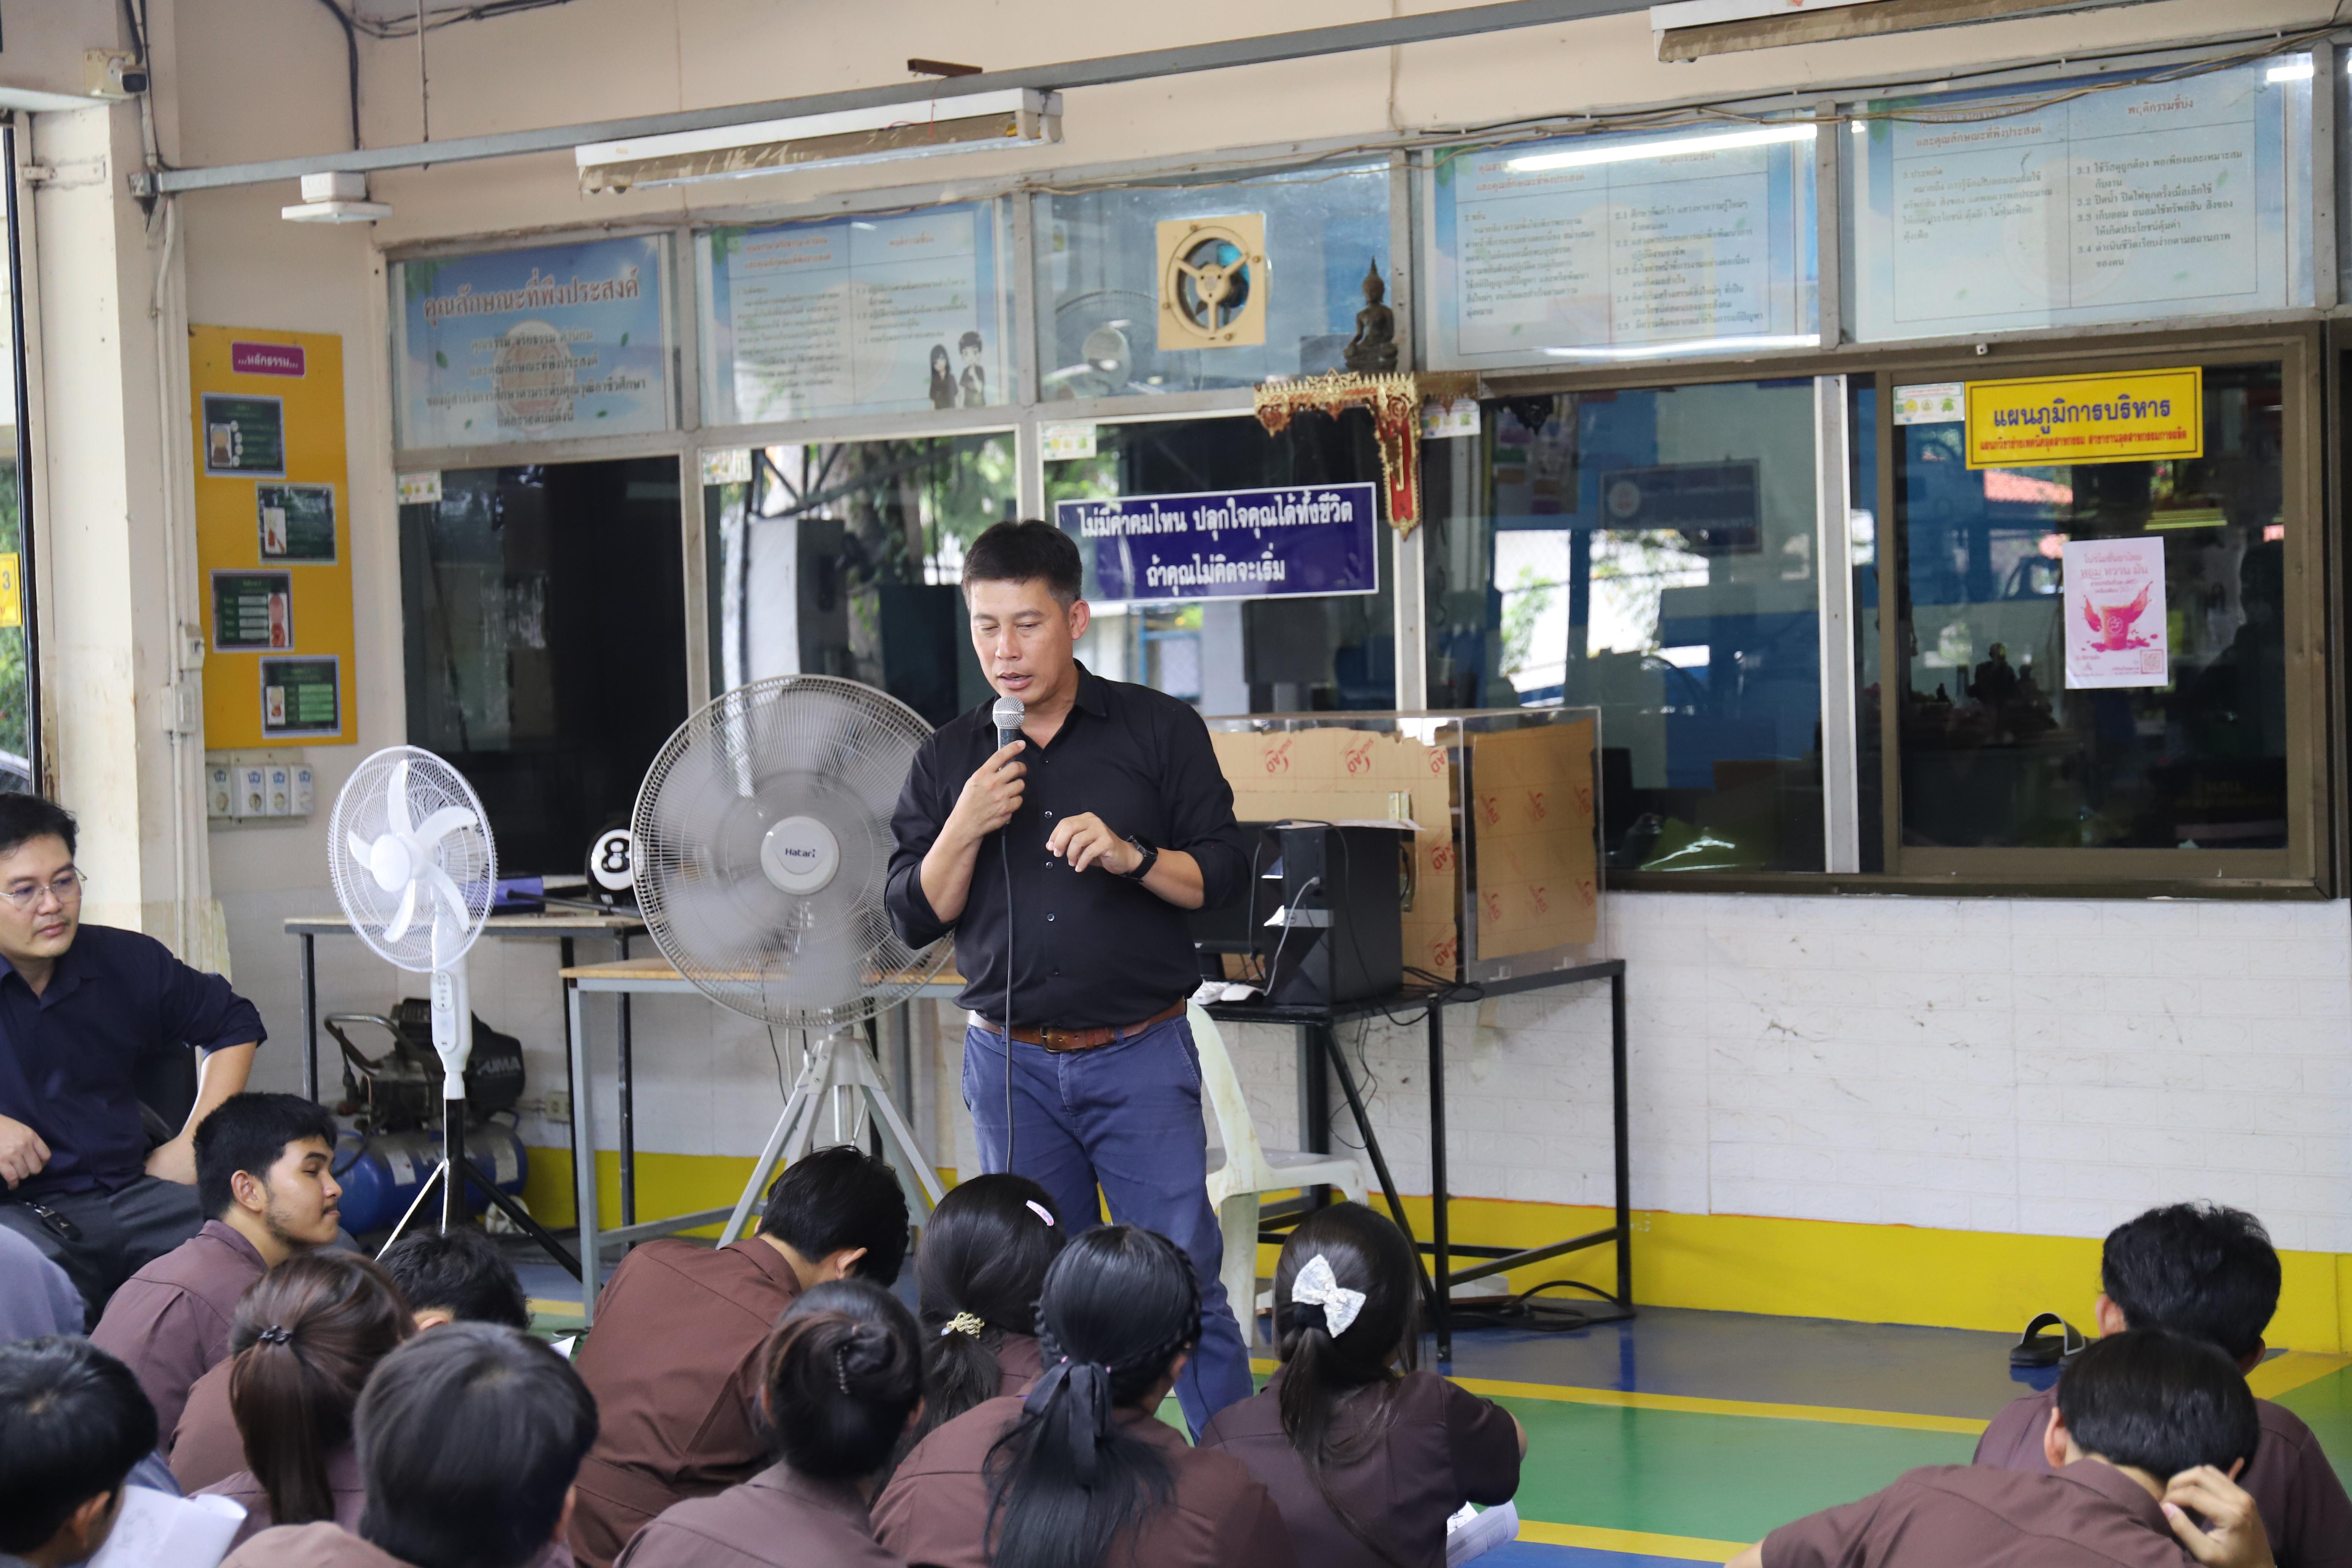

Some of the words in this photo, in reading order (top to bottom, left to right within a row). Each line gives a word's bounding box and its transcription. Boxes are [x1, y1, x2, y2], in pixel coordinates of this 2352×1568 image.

[2076, 165, 2091, 175] 3.1
[2076, 197, 2092, 207] 3.2
[2077, 212, 2092, 222] 3.3
[2077, 245, 2092, 254] 3.4
[424, 268, 640, 327] คุณลักษณะที่พึงประสงค์
[1994, 394, 2171, 434] แผนภูมิการบริหาร
[1192, 490, 1353, 542] ปลุกใจคุณได้ทั้งชีวิต
[1146, 542, 1286, 596] ถ้าคุณไม่คิดจะเริ่ม
[601, 838, 630, 873] 8
[785, 848, 816, 858] Hatari
